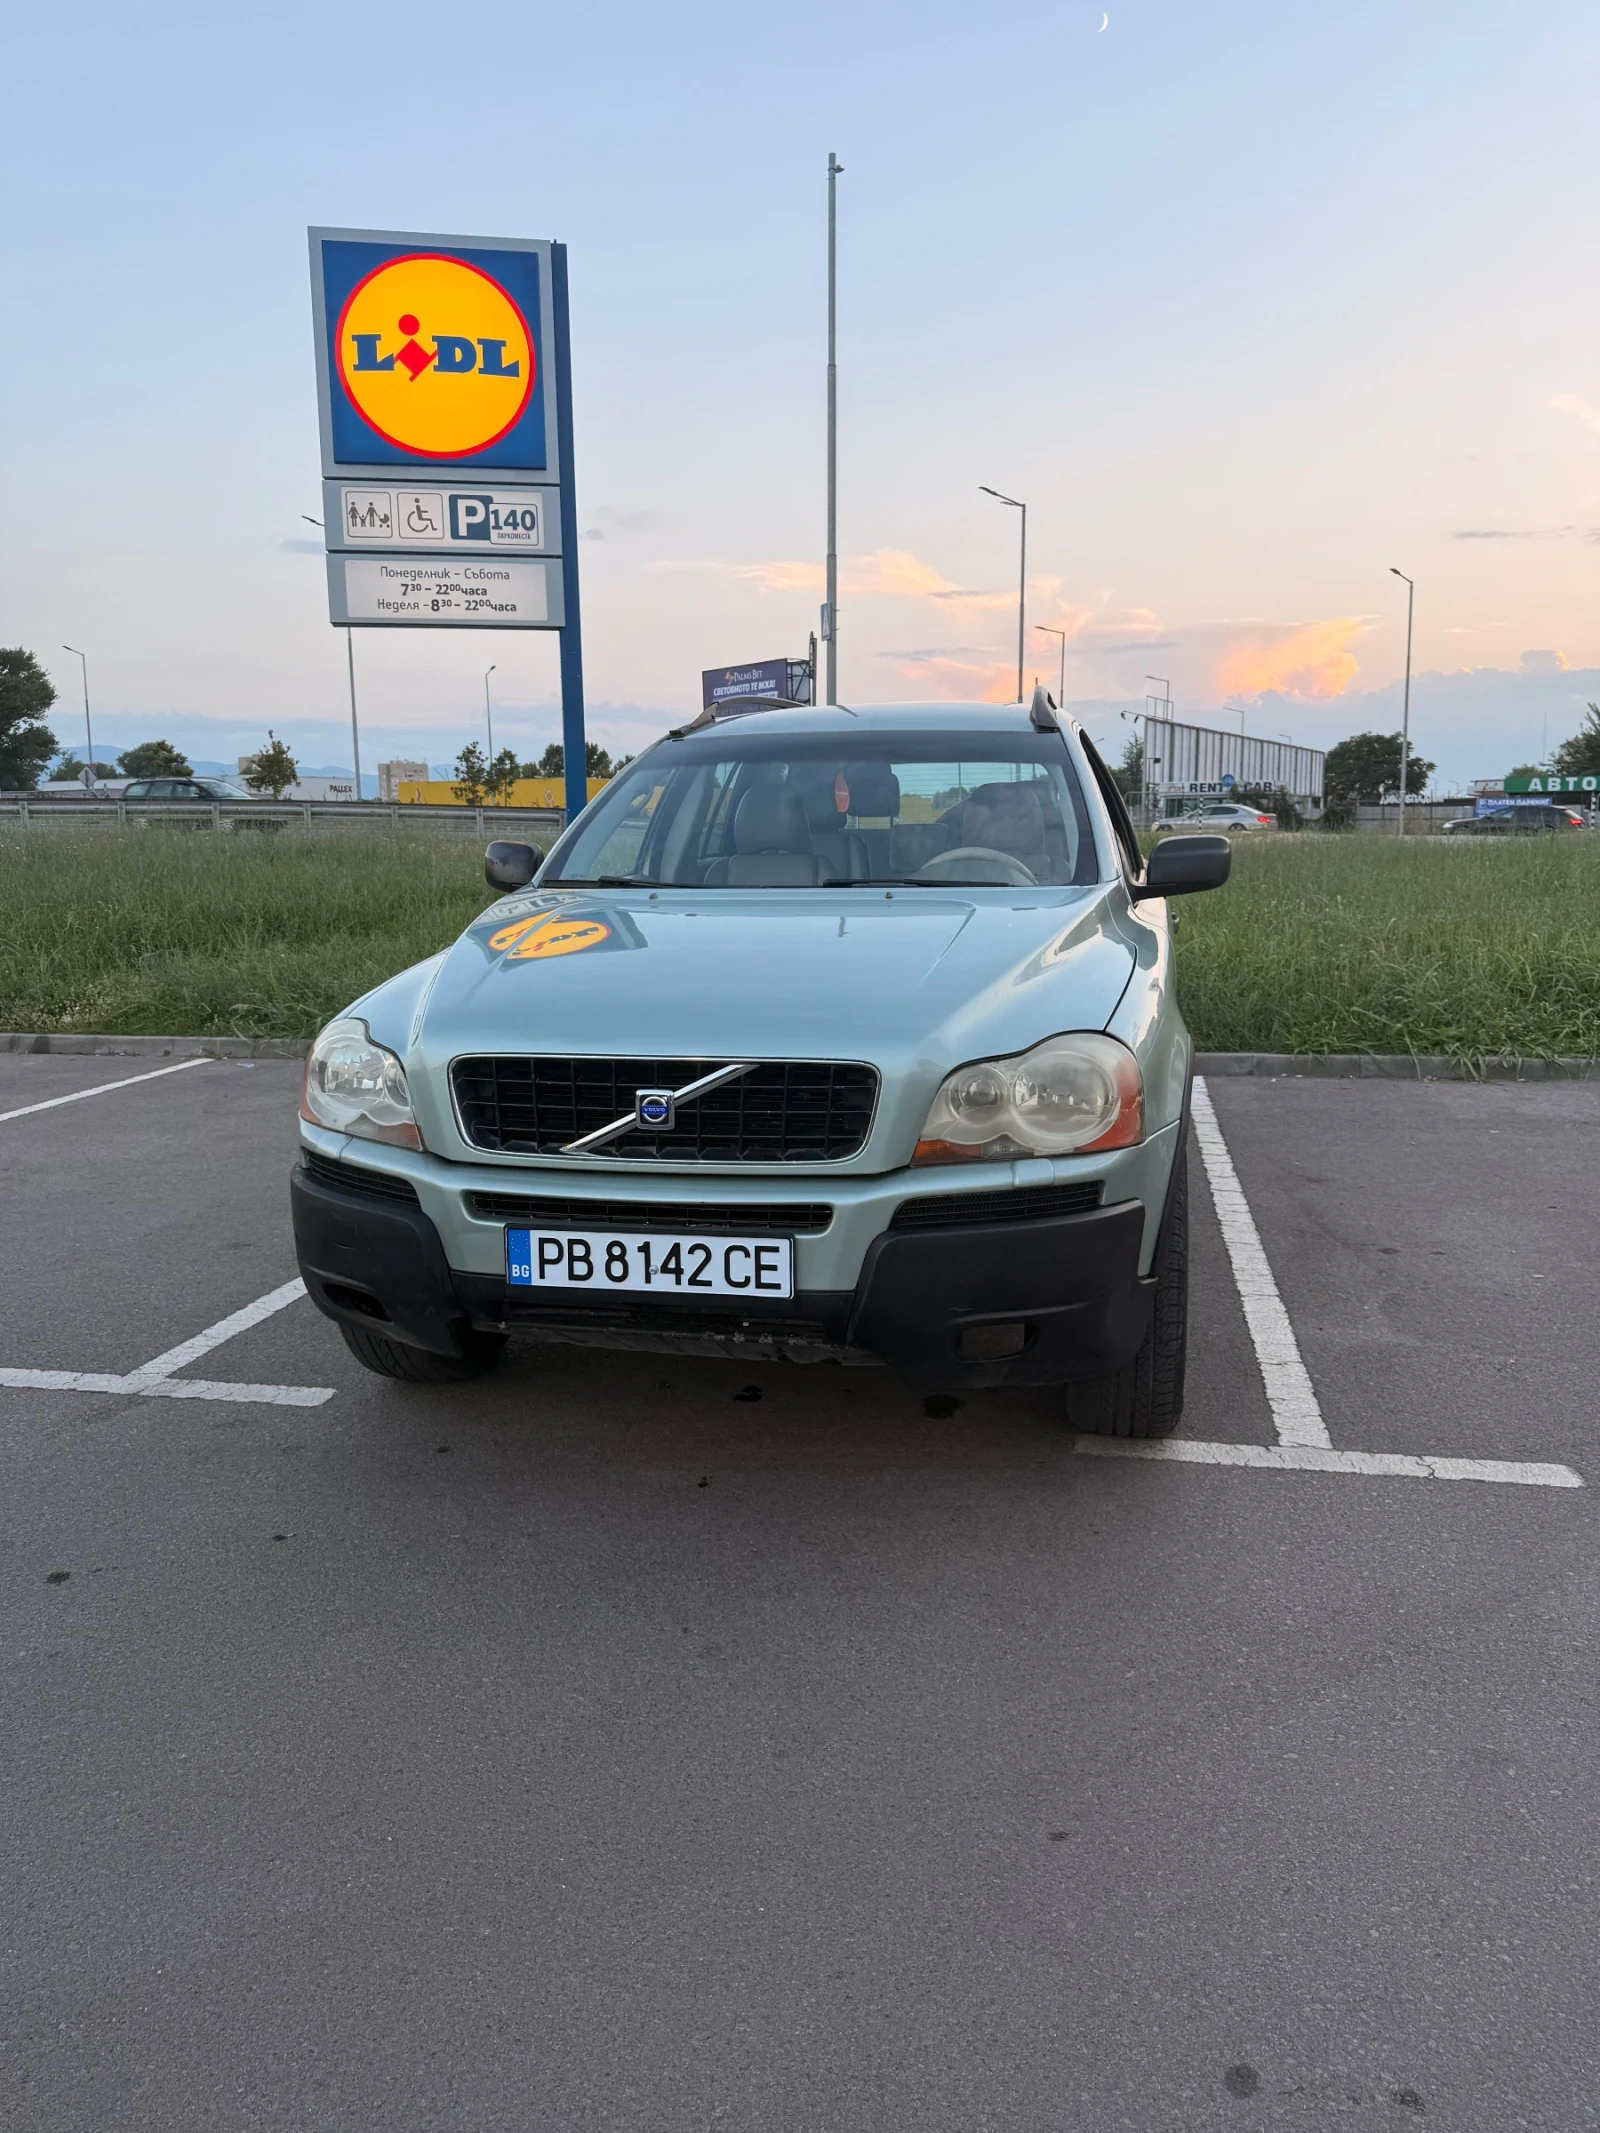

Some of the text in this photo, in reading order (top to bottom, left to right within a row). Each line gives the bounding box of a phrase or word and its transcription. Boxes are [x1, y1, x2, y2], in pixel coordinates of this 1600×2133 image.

[457, 499, 486, 537] P
[490, 508, 536, 531] 140
[380, 566, 451, 581] Понеделник
[464, 567, 510, 580] Събота
[377, 598, 420, 613] Неделя
[1189, 783, 1223, 793] RENT
[1528, 776, 1598, 792] АВТО
[511, 1264, 530, 1278] BG
[538, 1237, 782, 1290] PB 8142 CE
